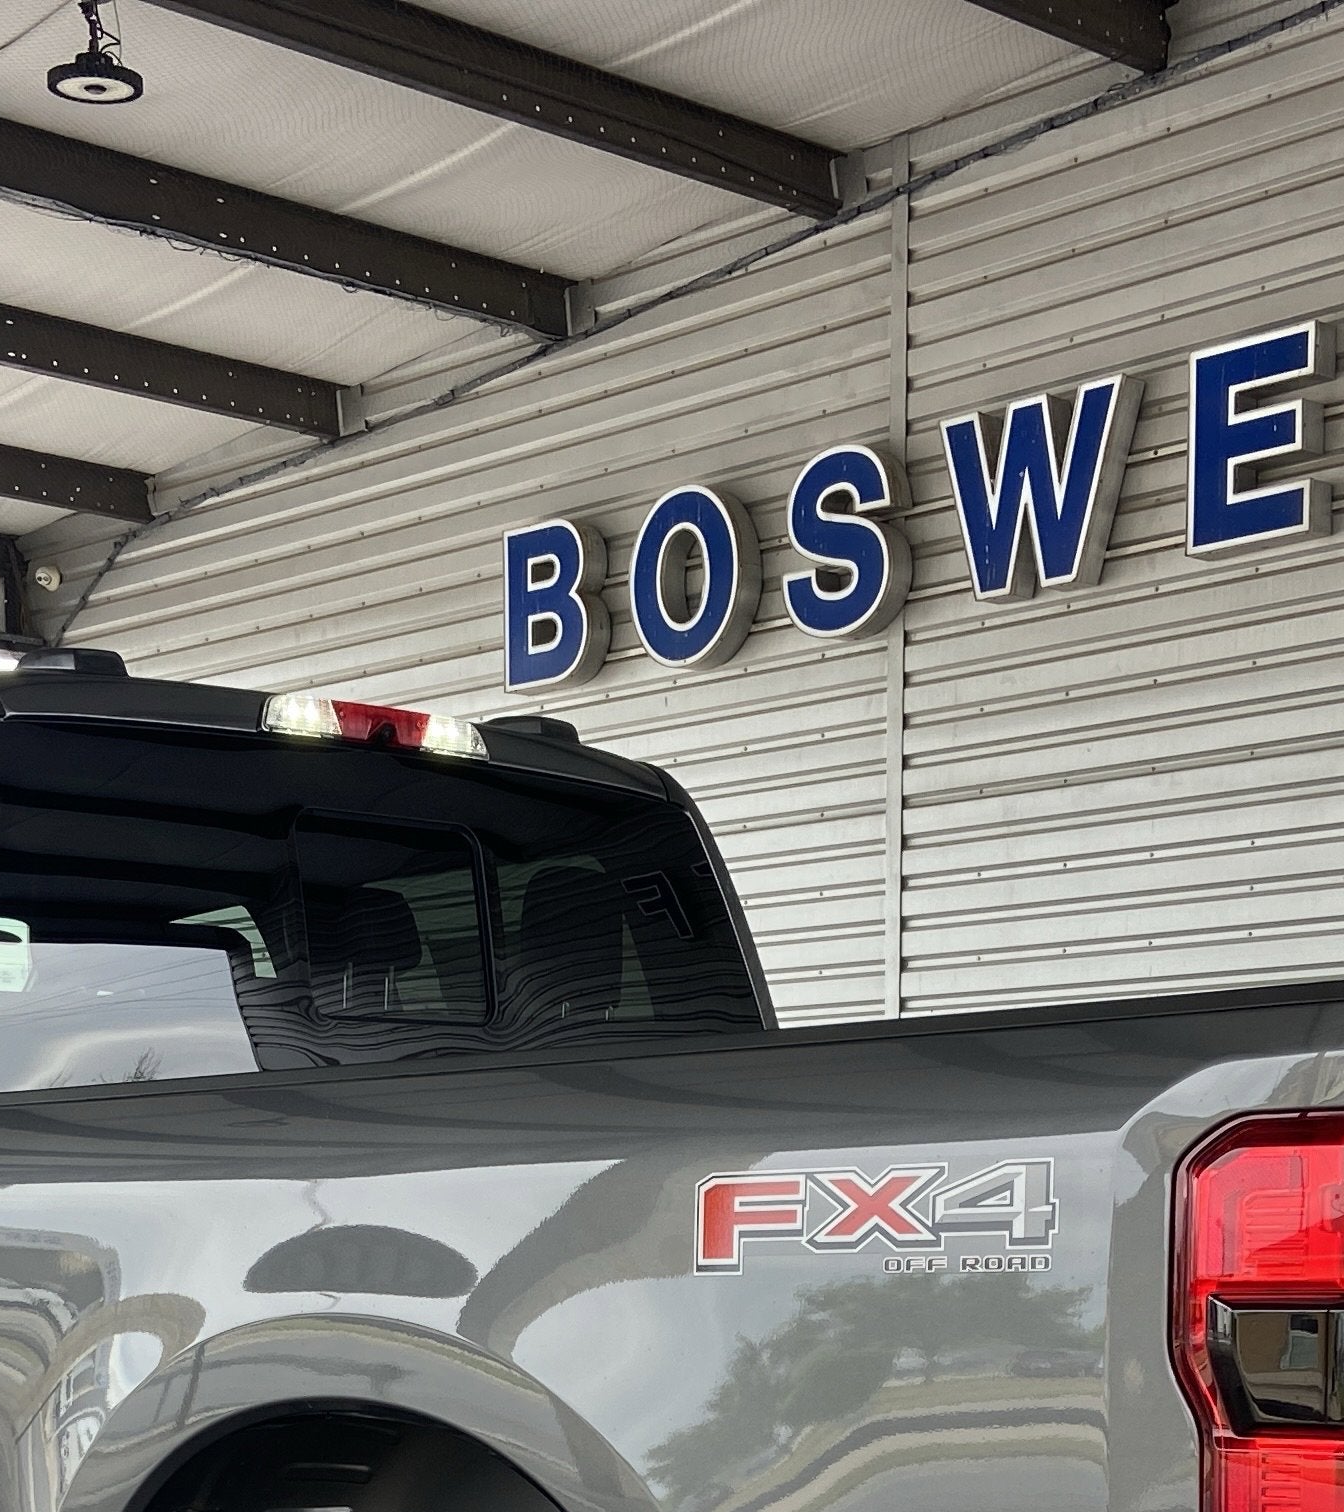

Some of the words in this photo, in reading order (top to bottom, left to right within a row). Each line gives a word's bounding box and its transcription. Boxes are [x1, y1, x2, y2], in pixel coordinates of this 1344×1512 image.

[694, 1157, 1059, 1276] FX4
[883, 1255, 949, 1274] OFF
[960, 1254, 1053, 1273] ROAD
